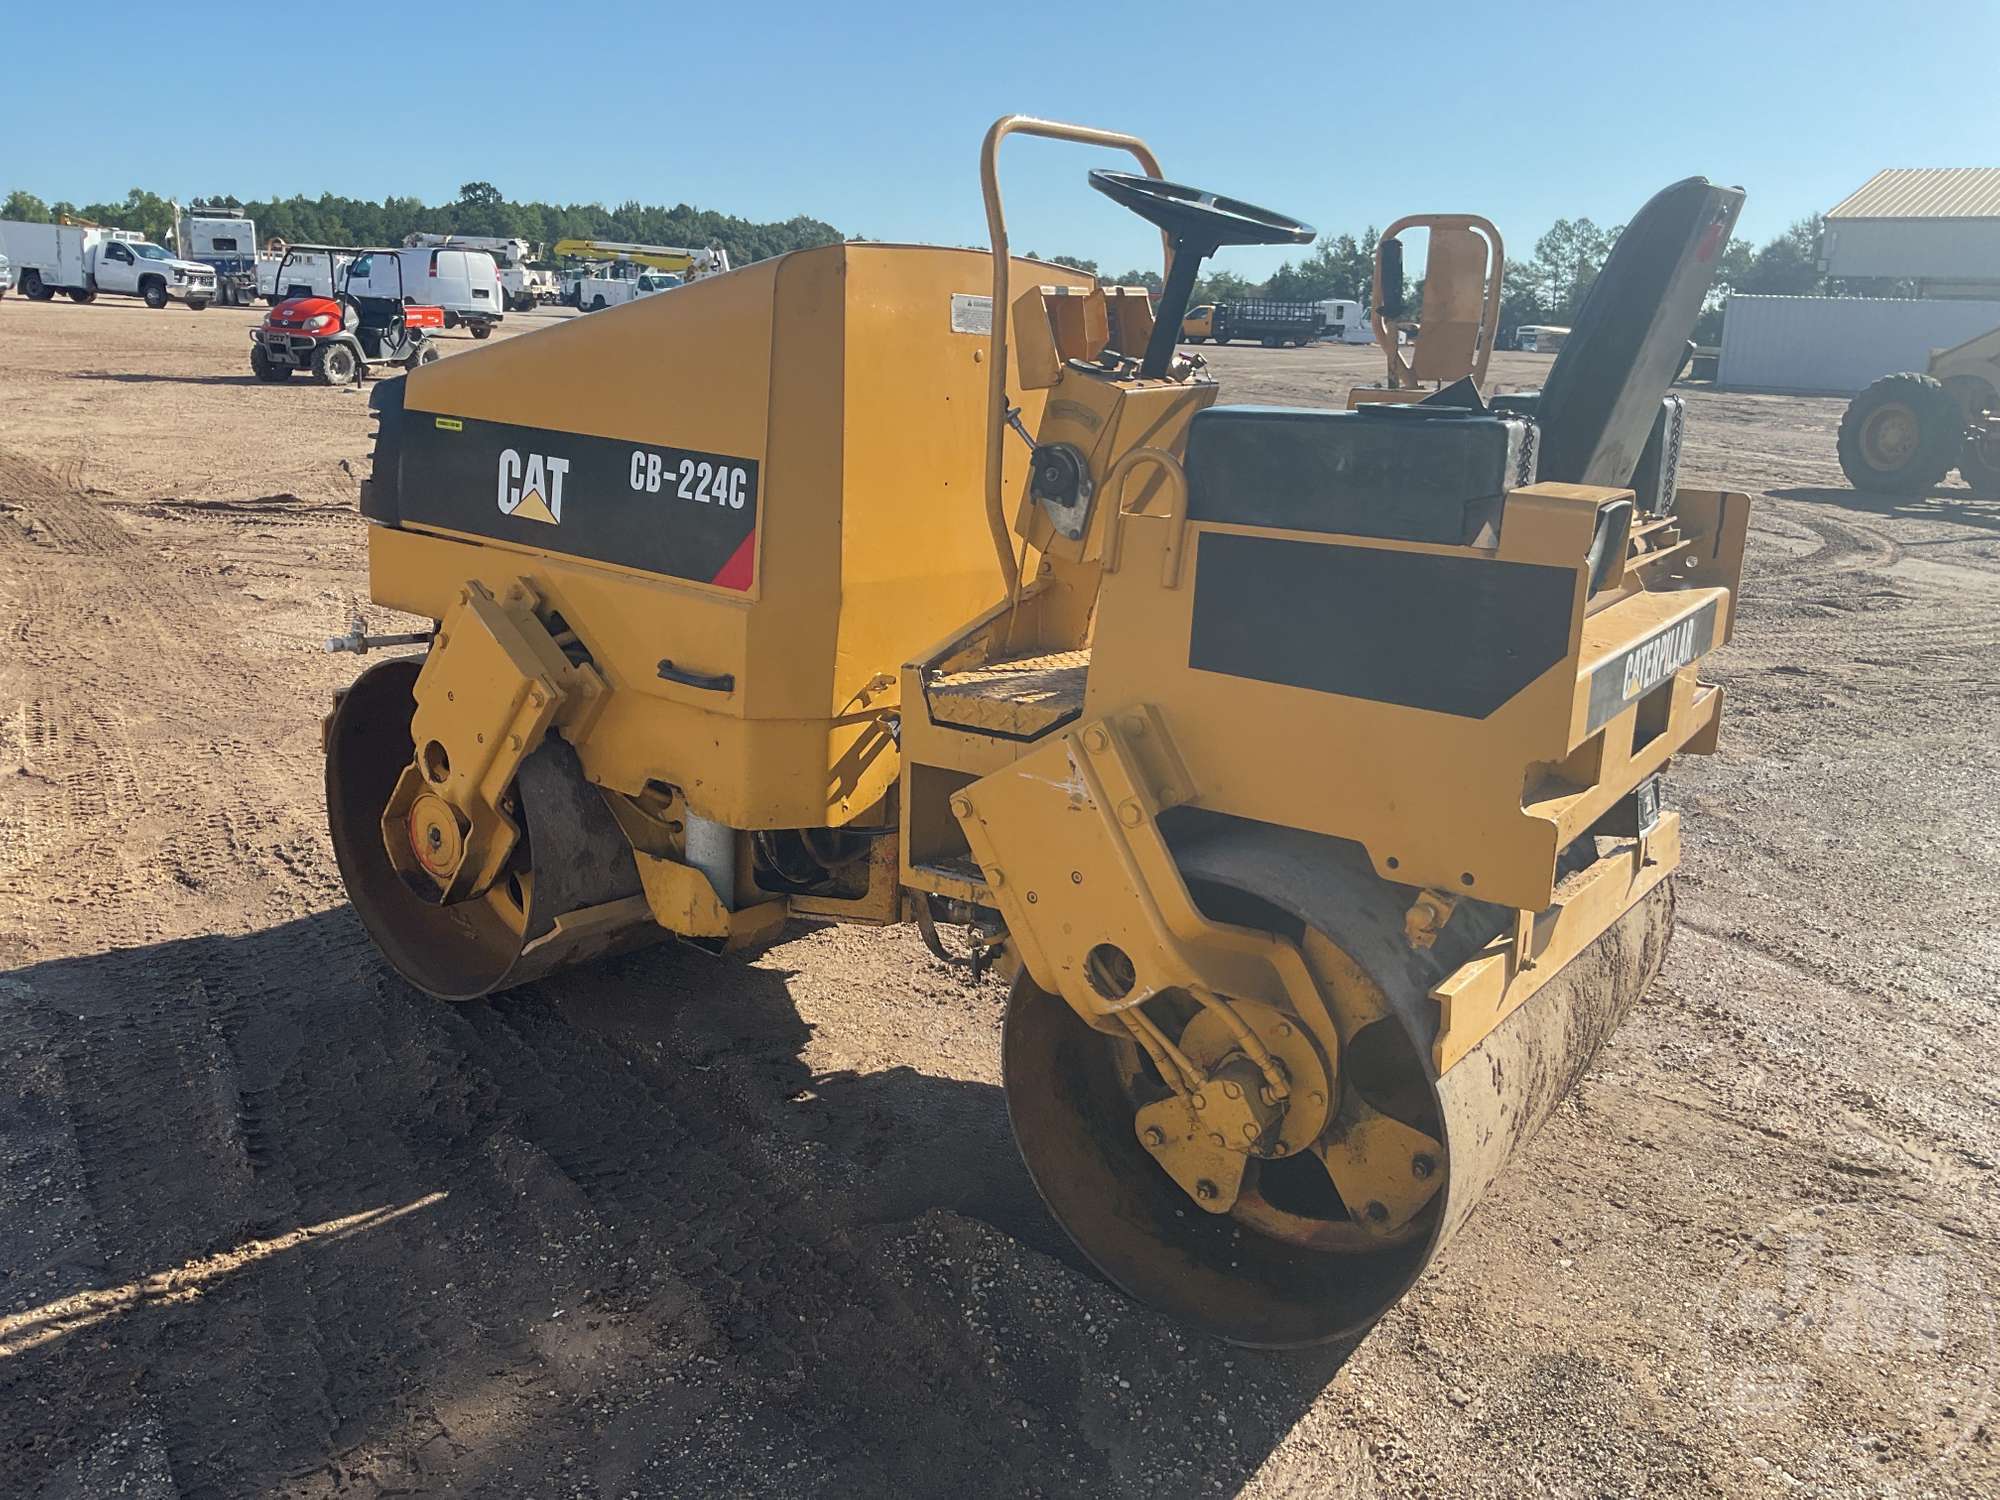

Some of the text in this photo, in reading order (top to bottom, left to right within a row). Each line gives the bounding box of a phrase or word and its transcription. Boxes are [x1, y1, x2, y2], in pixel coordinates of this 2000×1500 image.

[498, 449, 569, 525] CAT
[630, 450, 747, 509] CB-224C
[1622, 618, 1695, 701] CATERPILLAR
